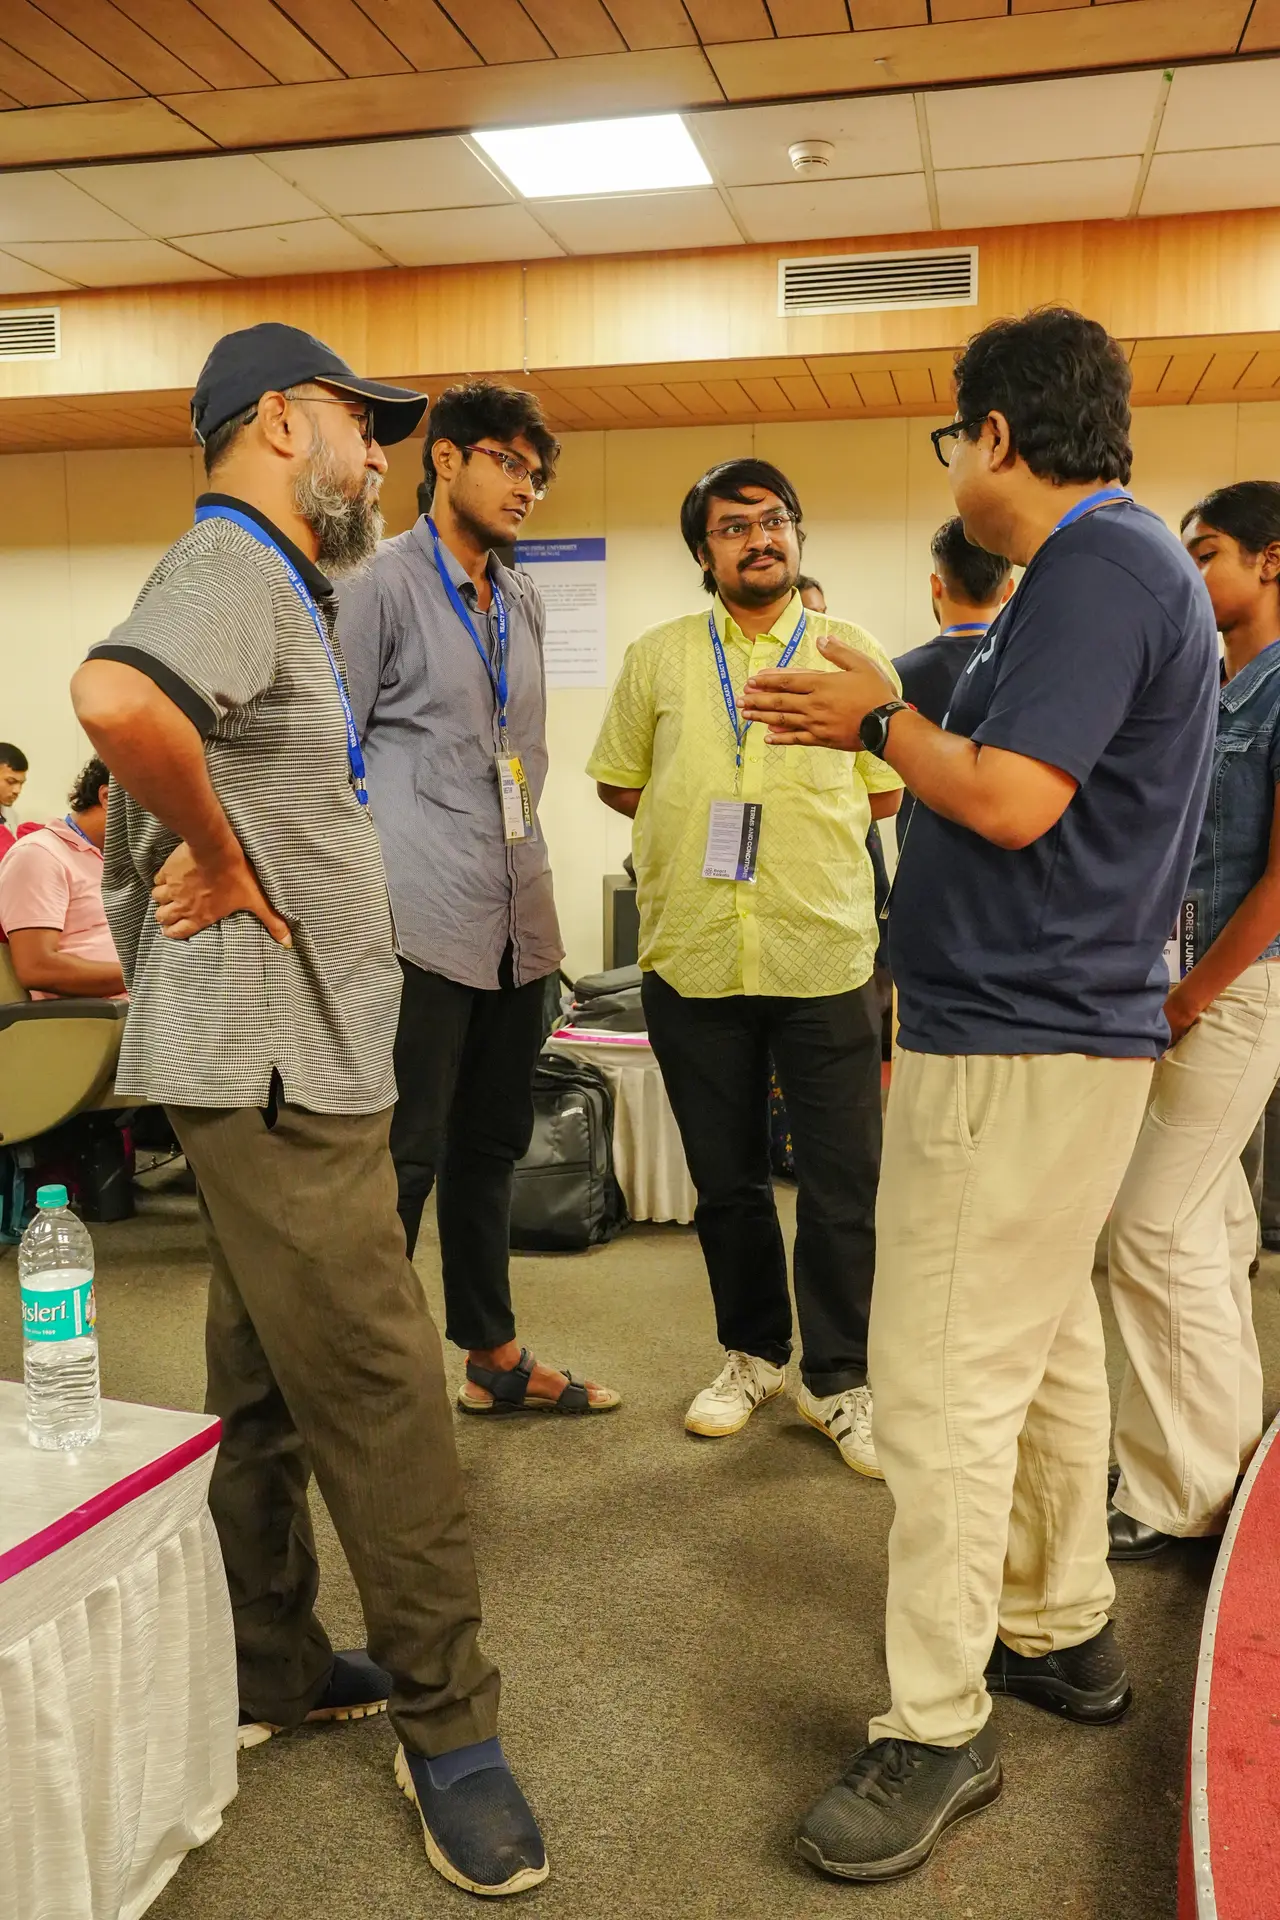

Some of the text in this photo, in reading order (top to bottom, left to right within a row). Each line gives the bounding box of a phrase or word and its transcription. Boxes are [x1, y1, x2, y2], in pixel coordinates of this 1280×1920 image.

[295, 582, 312, 608] REACT
[793, 629, 803, 642] REACT
[714, 642, 724, 664] KOLKATA
[779, 646, 794, 667] KOLKATA
[723, 683, 731, 708] KOLKATA
[348, 724, 357, 748] REACT
[521, 783, 531, 827] TENDEE
[742, 842, 753, 879] CONDITIONS
[1185, 903, 1194, 974] CORE'S JUNIO
